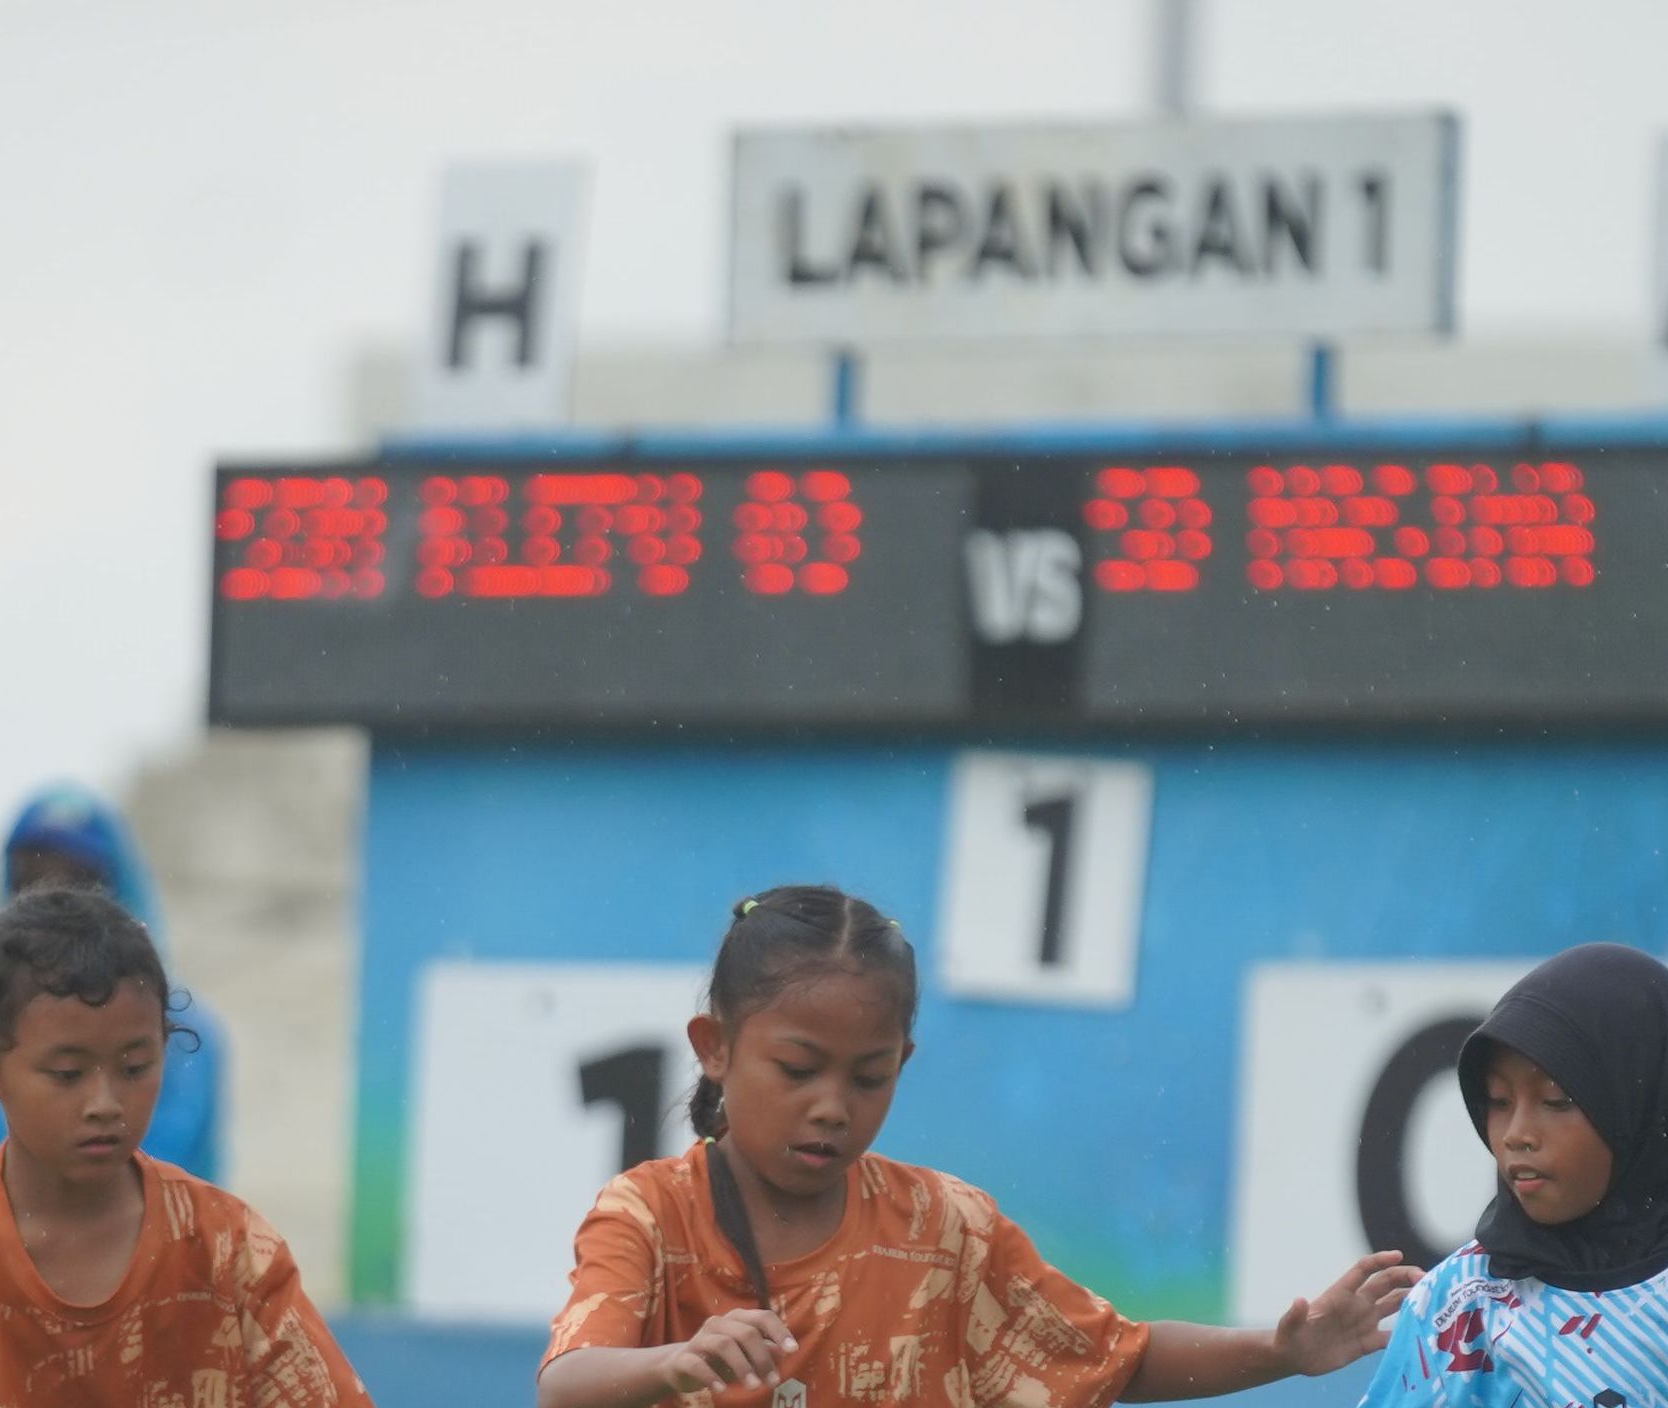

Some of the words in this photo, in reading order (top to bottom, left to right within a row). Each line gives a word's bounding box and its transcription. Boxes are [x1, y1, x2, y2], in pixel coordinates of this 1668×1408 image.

[778, 172, 1322, 287] LAPANGAN
[1360, 170, 1390, 274] 1
[446, 240, 551, 371] H
[963, 529, 1084, 645] VS
[1019, 788, 1086, 970] 1
